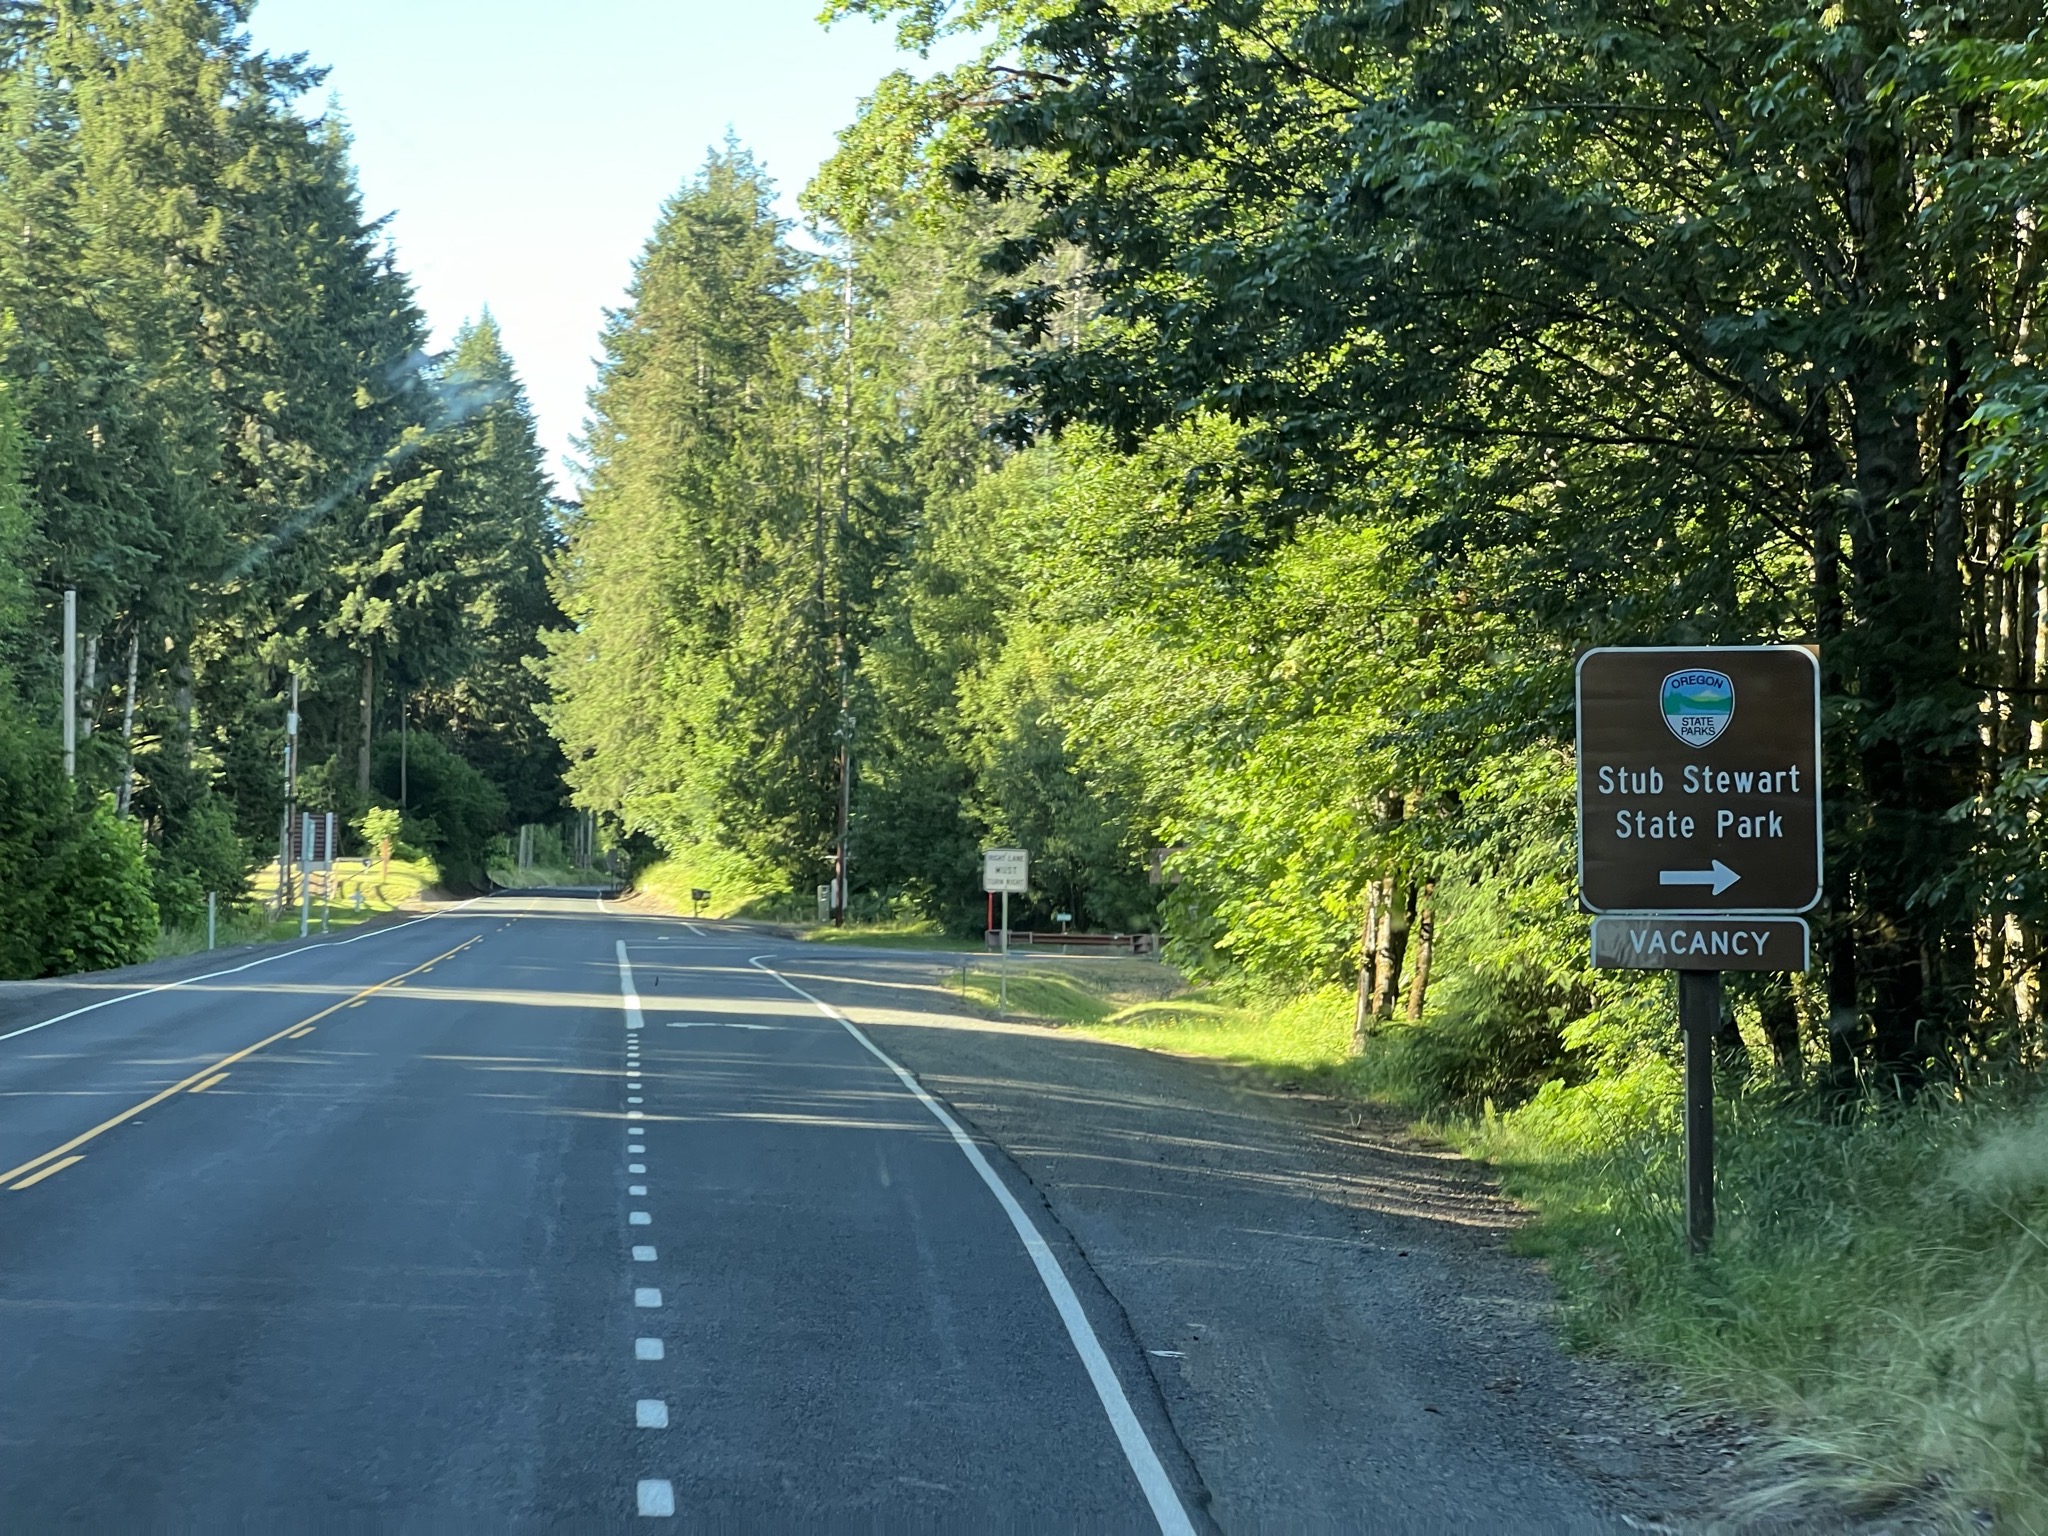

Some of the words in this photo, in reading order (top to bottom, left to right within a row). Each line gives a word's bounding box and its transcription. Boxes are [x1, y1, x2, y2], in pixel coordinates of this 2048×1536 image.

[1671, 675, 1723, 689] OREGON
[1681, 716, 1714, 726] STATE
[1681, 726, 1716, 736] PARKS
[1598, 766, 1664, 795] Stub
[1682, 764, 1800, 794] Stewart
[1615, 810, 1695, 839] State
[1717, 809, 1784, 838] Park
[1629, 929, 1770, 956] VACANCY
